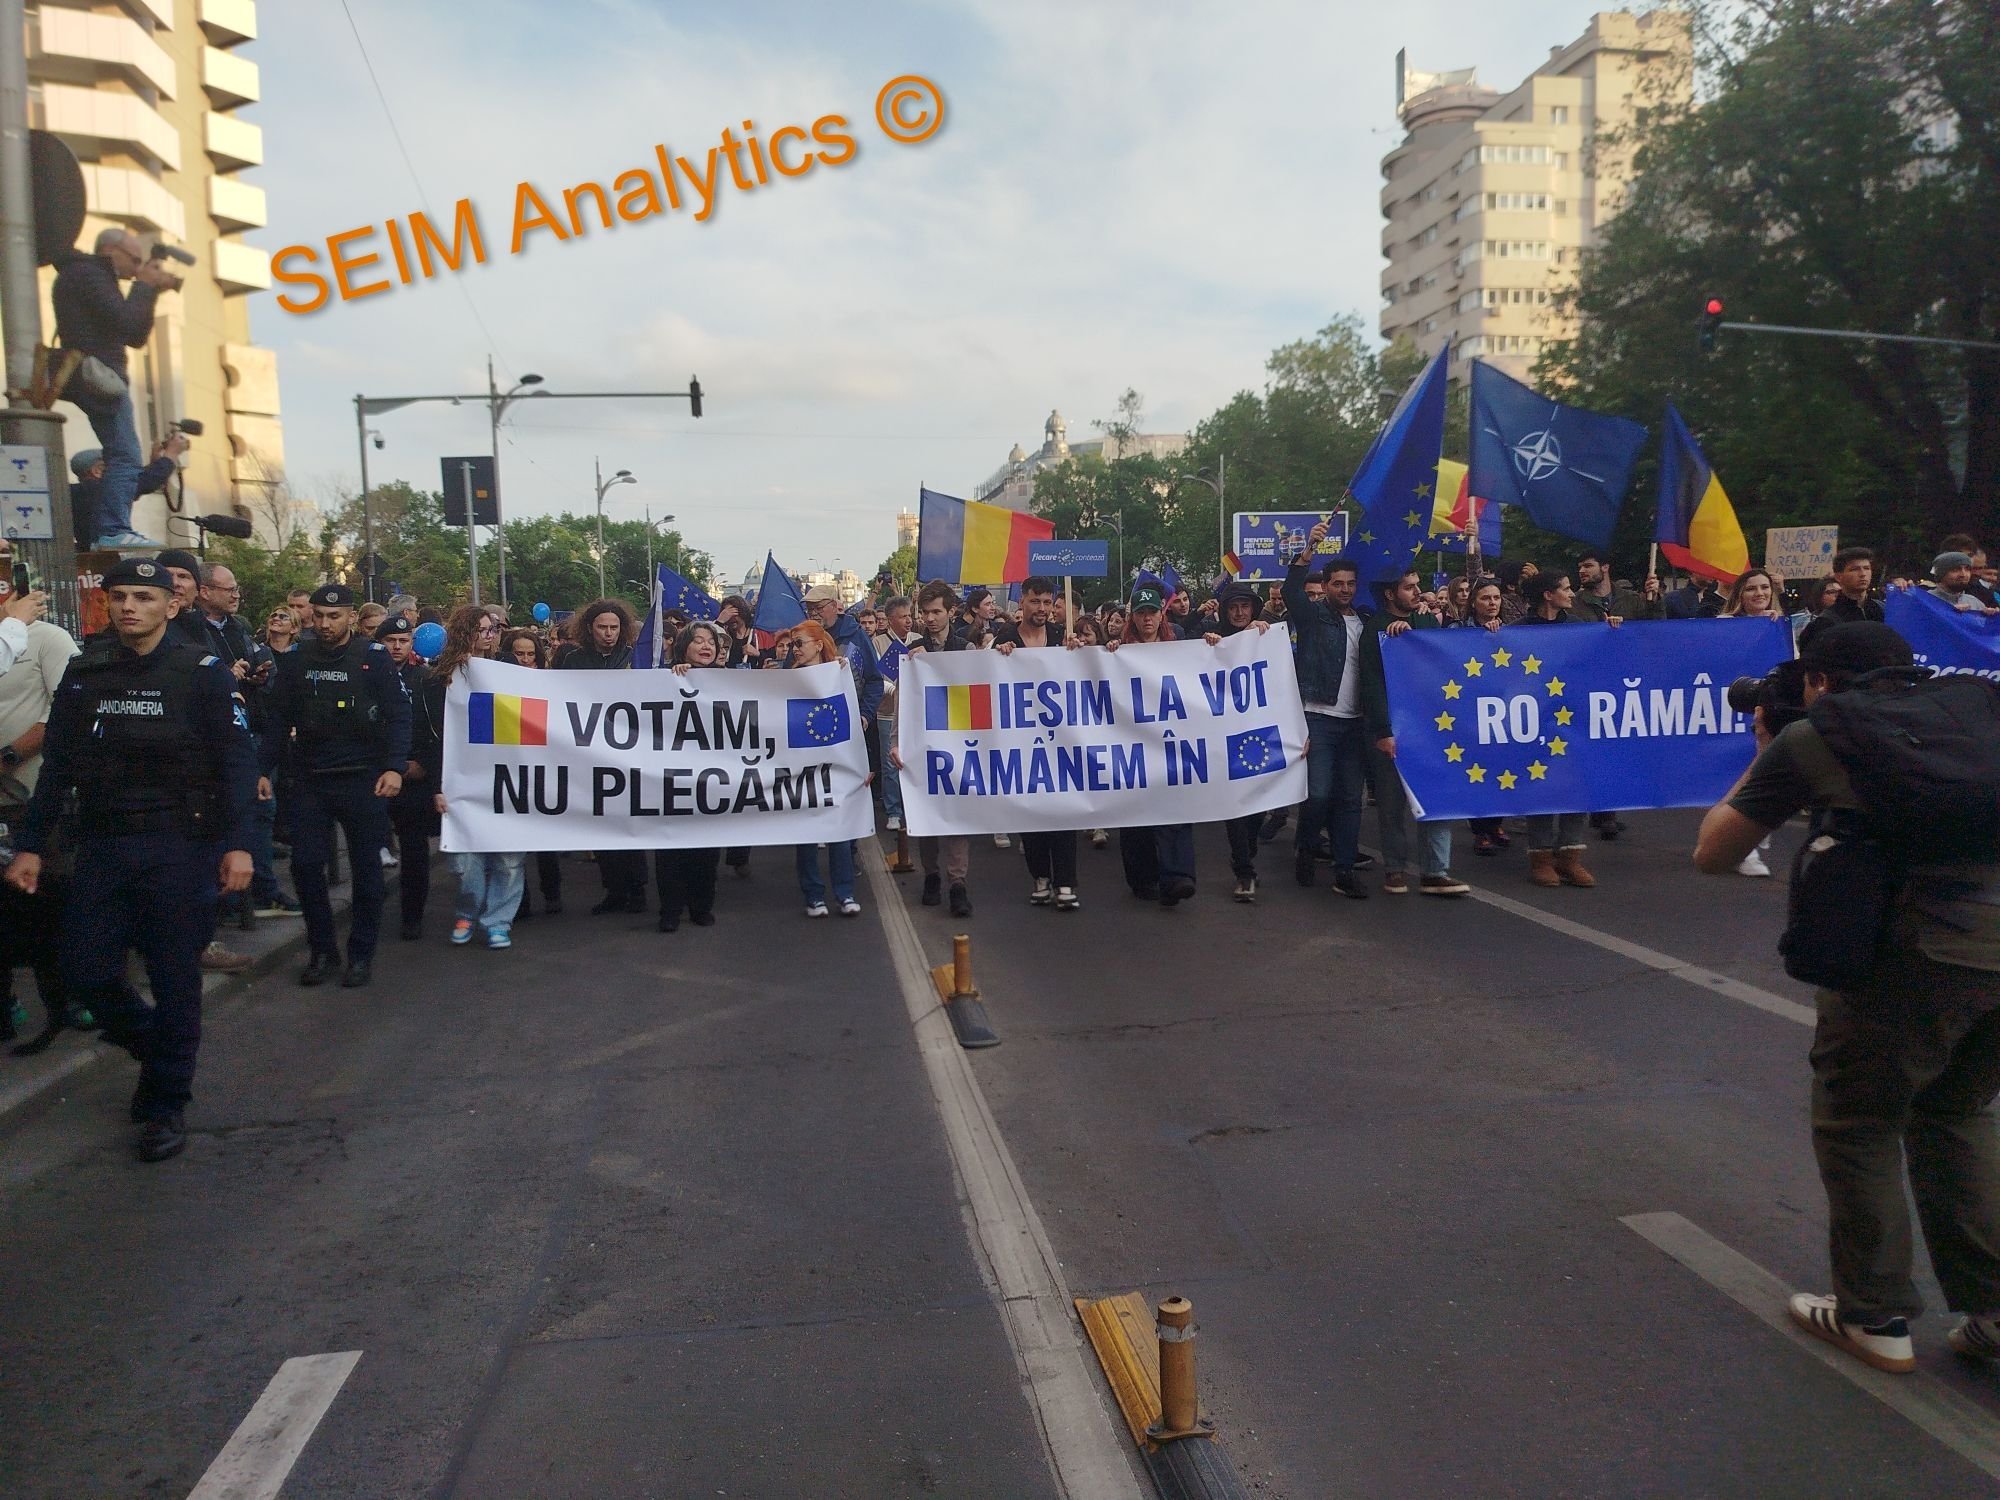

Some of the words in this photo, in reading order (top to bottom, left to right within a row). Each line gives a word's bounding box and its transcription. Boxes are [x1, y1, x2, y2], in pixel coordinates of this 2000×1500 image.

[1031, 553, 1058, 562] fiecare
[1768, 554, 1806, 567] VREAU
[305, 669, 348, 682] JANDARMERIA
[999, 679, 1115, 742] IEȘIM
[1130, 674, 1188, 724] LA
[1199, 660, 1268, 717] VOT
[96, 699, 164, 716] JANDARMERIA
[565, 687, 776, 760] VOTĂM,
[1476, 694, 1547, 747] RO,
[493, 763, 568, 815] NU
[592, 755, 835, 817] PLECĂM!
[926, 736, 1148, 796] RĂMÂNEM
[1162, 729, 1209, 787] ÎN
